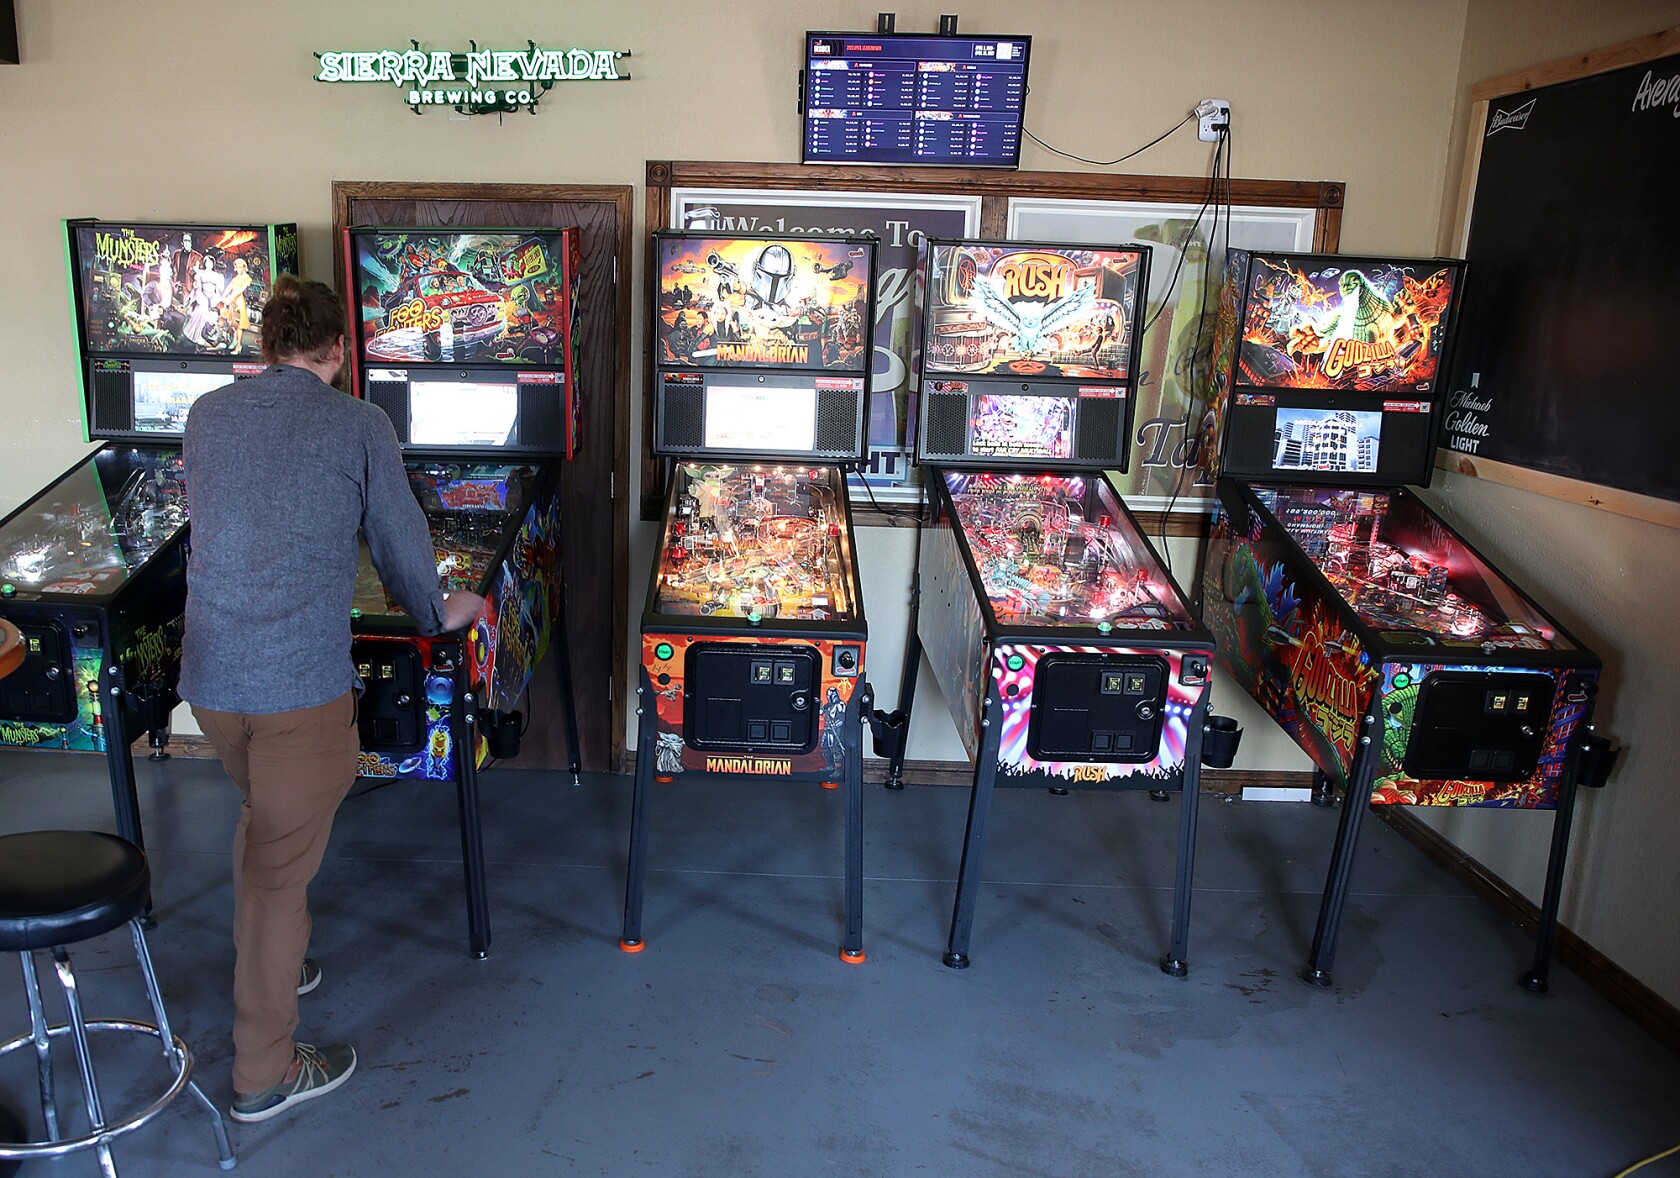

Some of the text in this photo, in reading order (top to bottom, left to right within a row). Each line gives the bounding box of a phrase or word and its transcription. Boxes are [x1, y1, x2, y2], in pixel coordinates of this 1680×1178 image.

[319, 48, 619, 87] SIERRA NEVADA
[408, 90, 535, 105] BREWING CO.
[1491, 111, 1530, 129] Budweiser
[121, 228, 135, 237] THE
[885, 220, 925, 248] To
[95, 232, 160, 268] MUNSTERS
[1001, 263, 1069, 303] RUSH
[390, 299, 424, 325] FOO
[716, 343, 809, 364] MANDALORIAN
[1325, 338, 1395, 377] GODZILLA
[1445, 410, 1490, 437] Golden
[1450, 435, 1480, 454] LIGHT
[1293, 631, 1358, 721] GODZILLA
[1, 726, 39, 745] MUNSTERS
[356, 751, 380, 764] OO
[706, 758, 792, 775] MANDALORIAN
[1073, 765, 1108, 784] RUSH
[1438, 778, 1486, 803] GODZILLA
